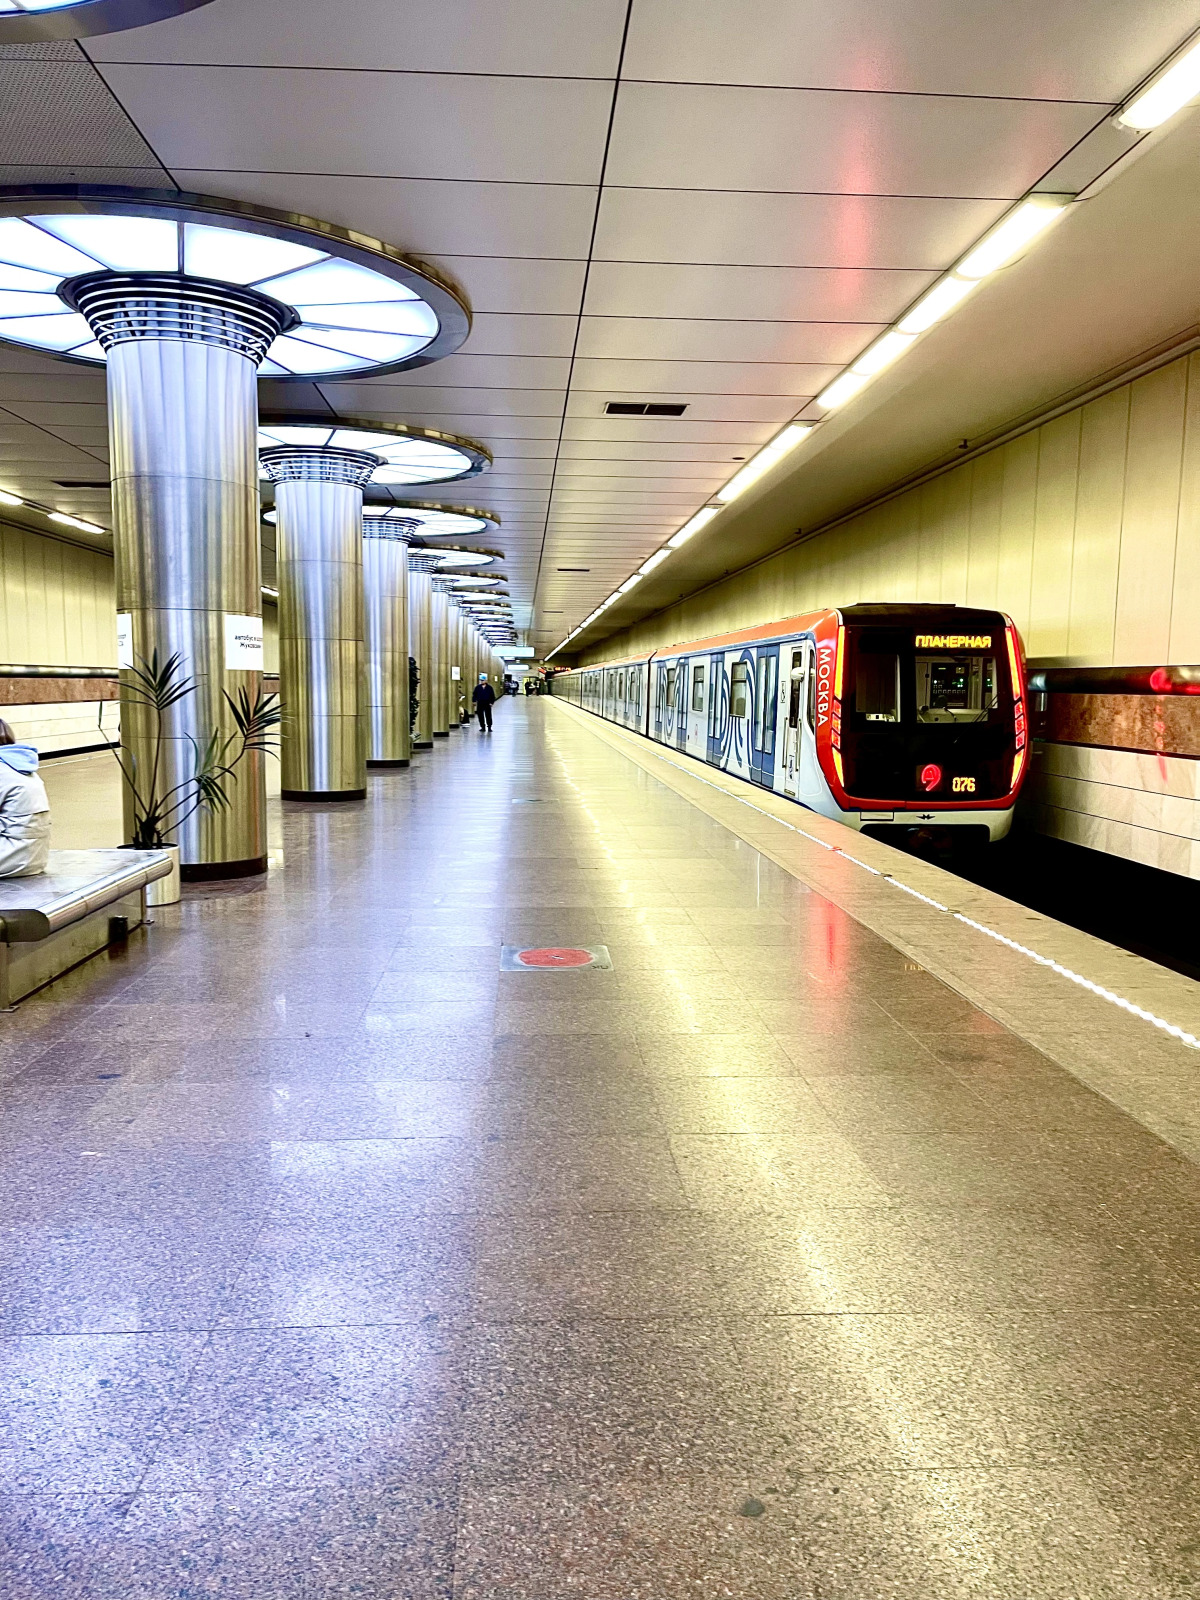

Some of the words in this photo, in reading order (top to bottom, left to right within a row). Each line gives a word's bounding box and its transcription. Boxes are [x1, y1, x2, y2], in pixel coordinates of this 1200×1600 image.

[915, 635, 992, 648] ПЛАНЕРНАЯ
[817, 648, 832, 727] МОСКВА
[952, 777, 976, 792] 076
